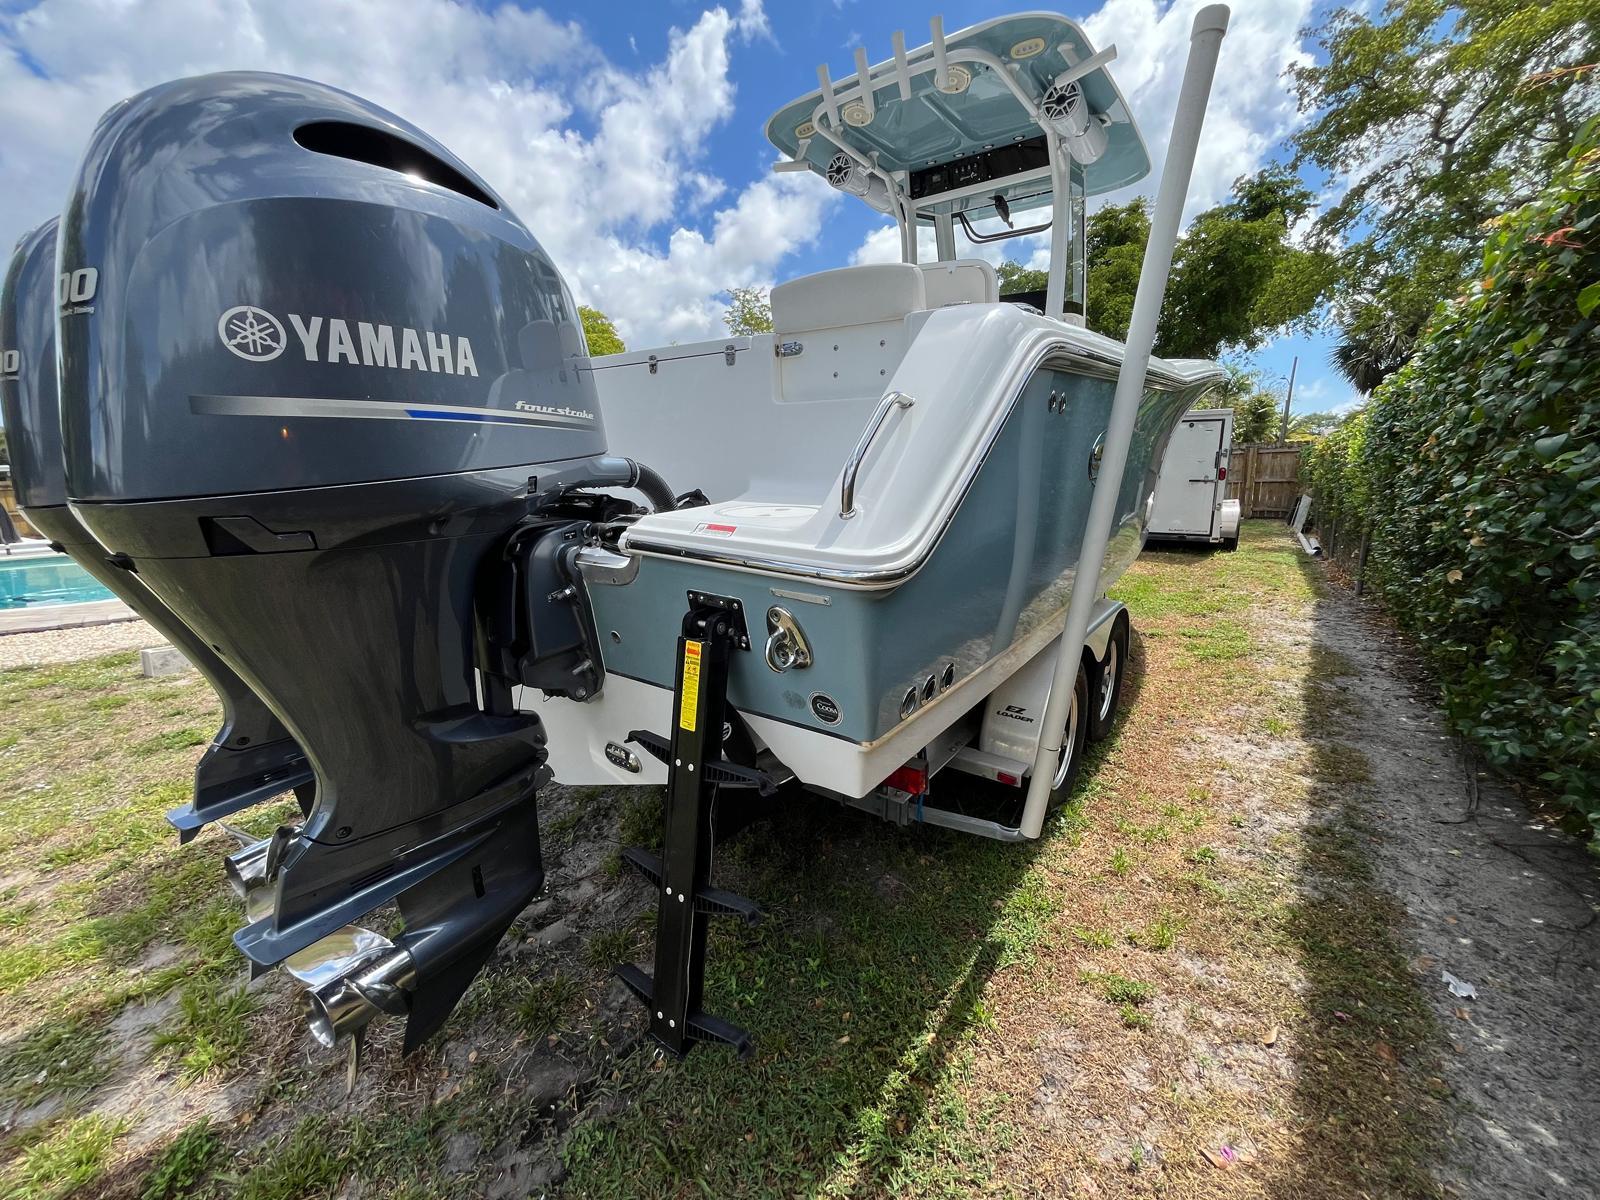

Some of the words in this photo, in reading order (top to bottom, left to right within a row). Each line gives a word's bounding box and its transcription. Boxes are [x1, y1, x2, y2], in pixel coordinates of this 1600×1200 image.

[288, 313, 479, 377] YAMAHA
[996, 710, 1035, 723] LOADER
[1005, 705, 1027, 715] EZ
